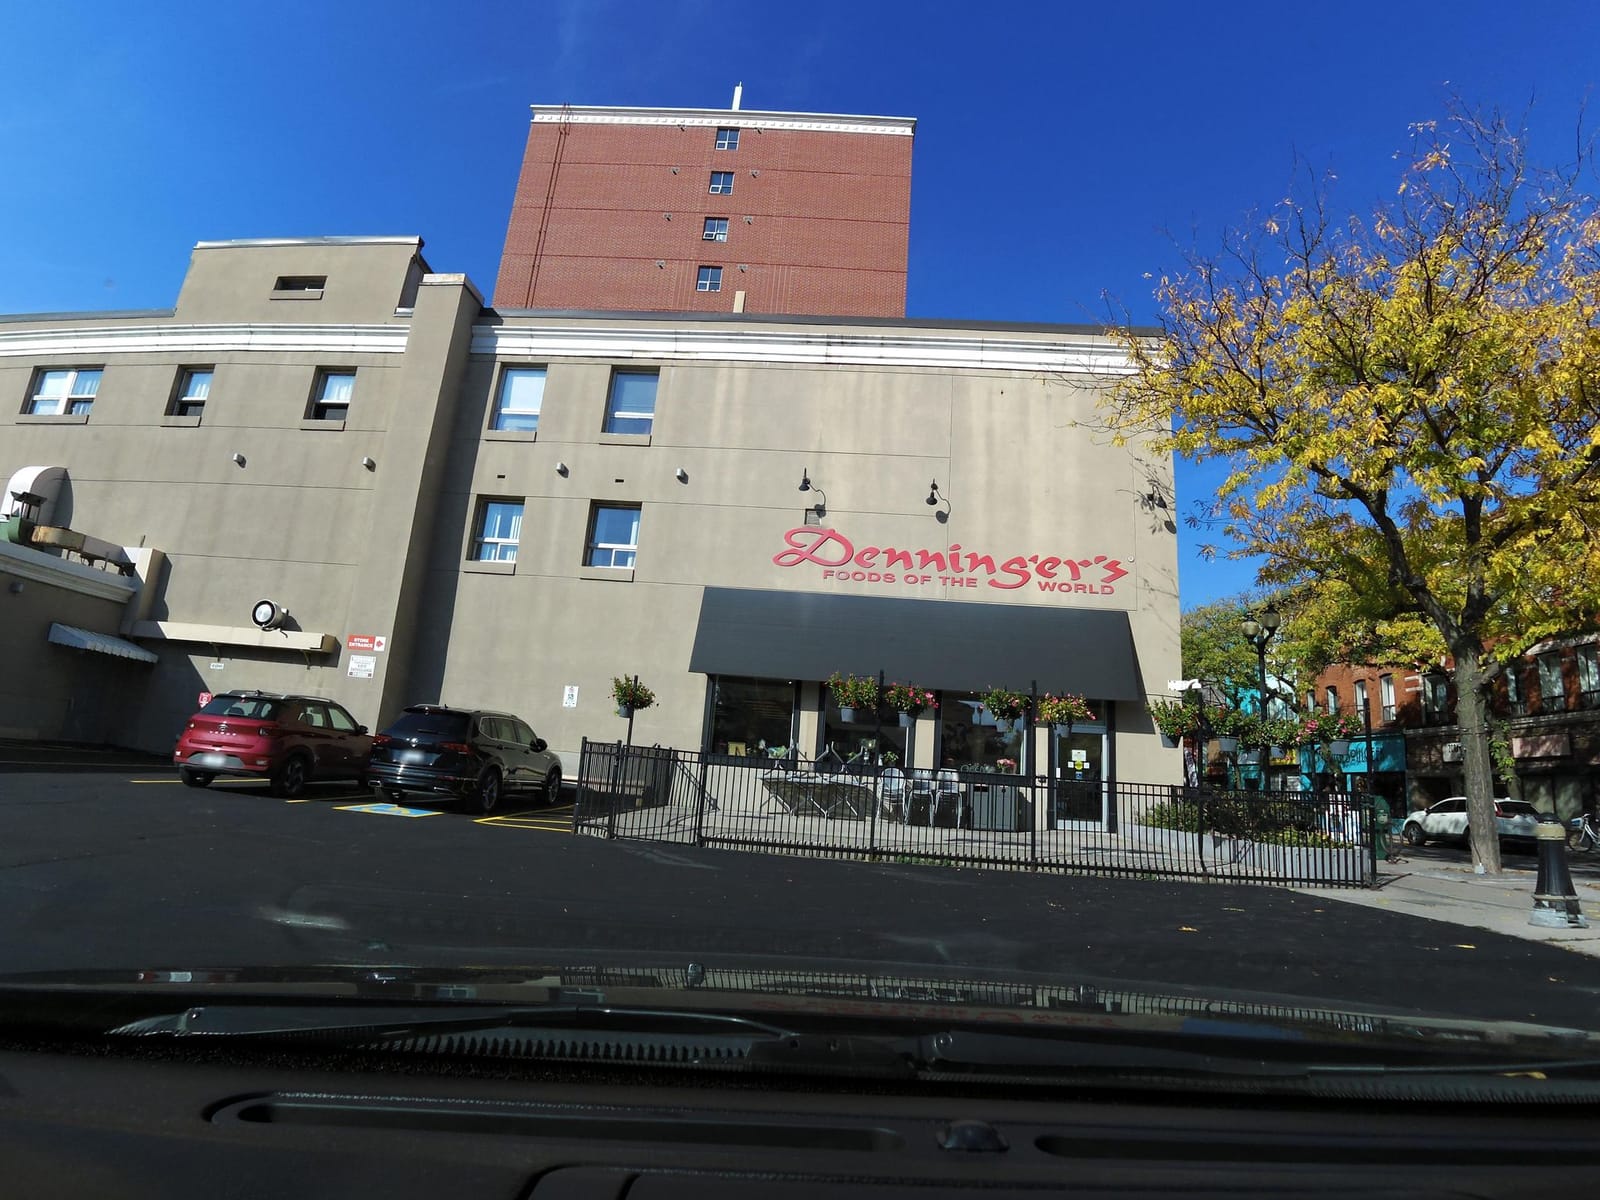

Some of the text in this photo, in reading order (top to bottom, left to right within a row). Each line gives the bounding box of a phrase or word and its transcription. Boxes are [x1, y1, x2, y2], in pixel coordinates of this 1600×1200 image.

[772, 527, 1129, 589] Denninger's
[823, 569, 1115, 595] FOODS OF THE WORLD
